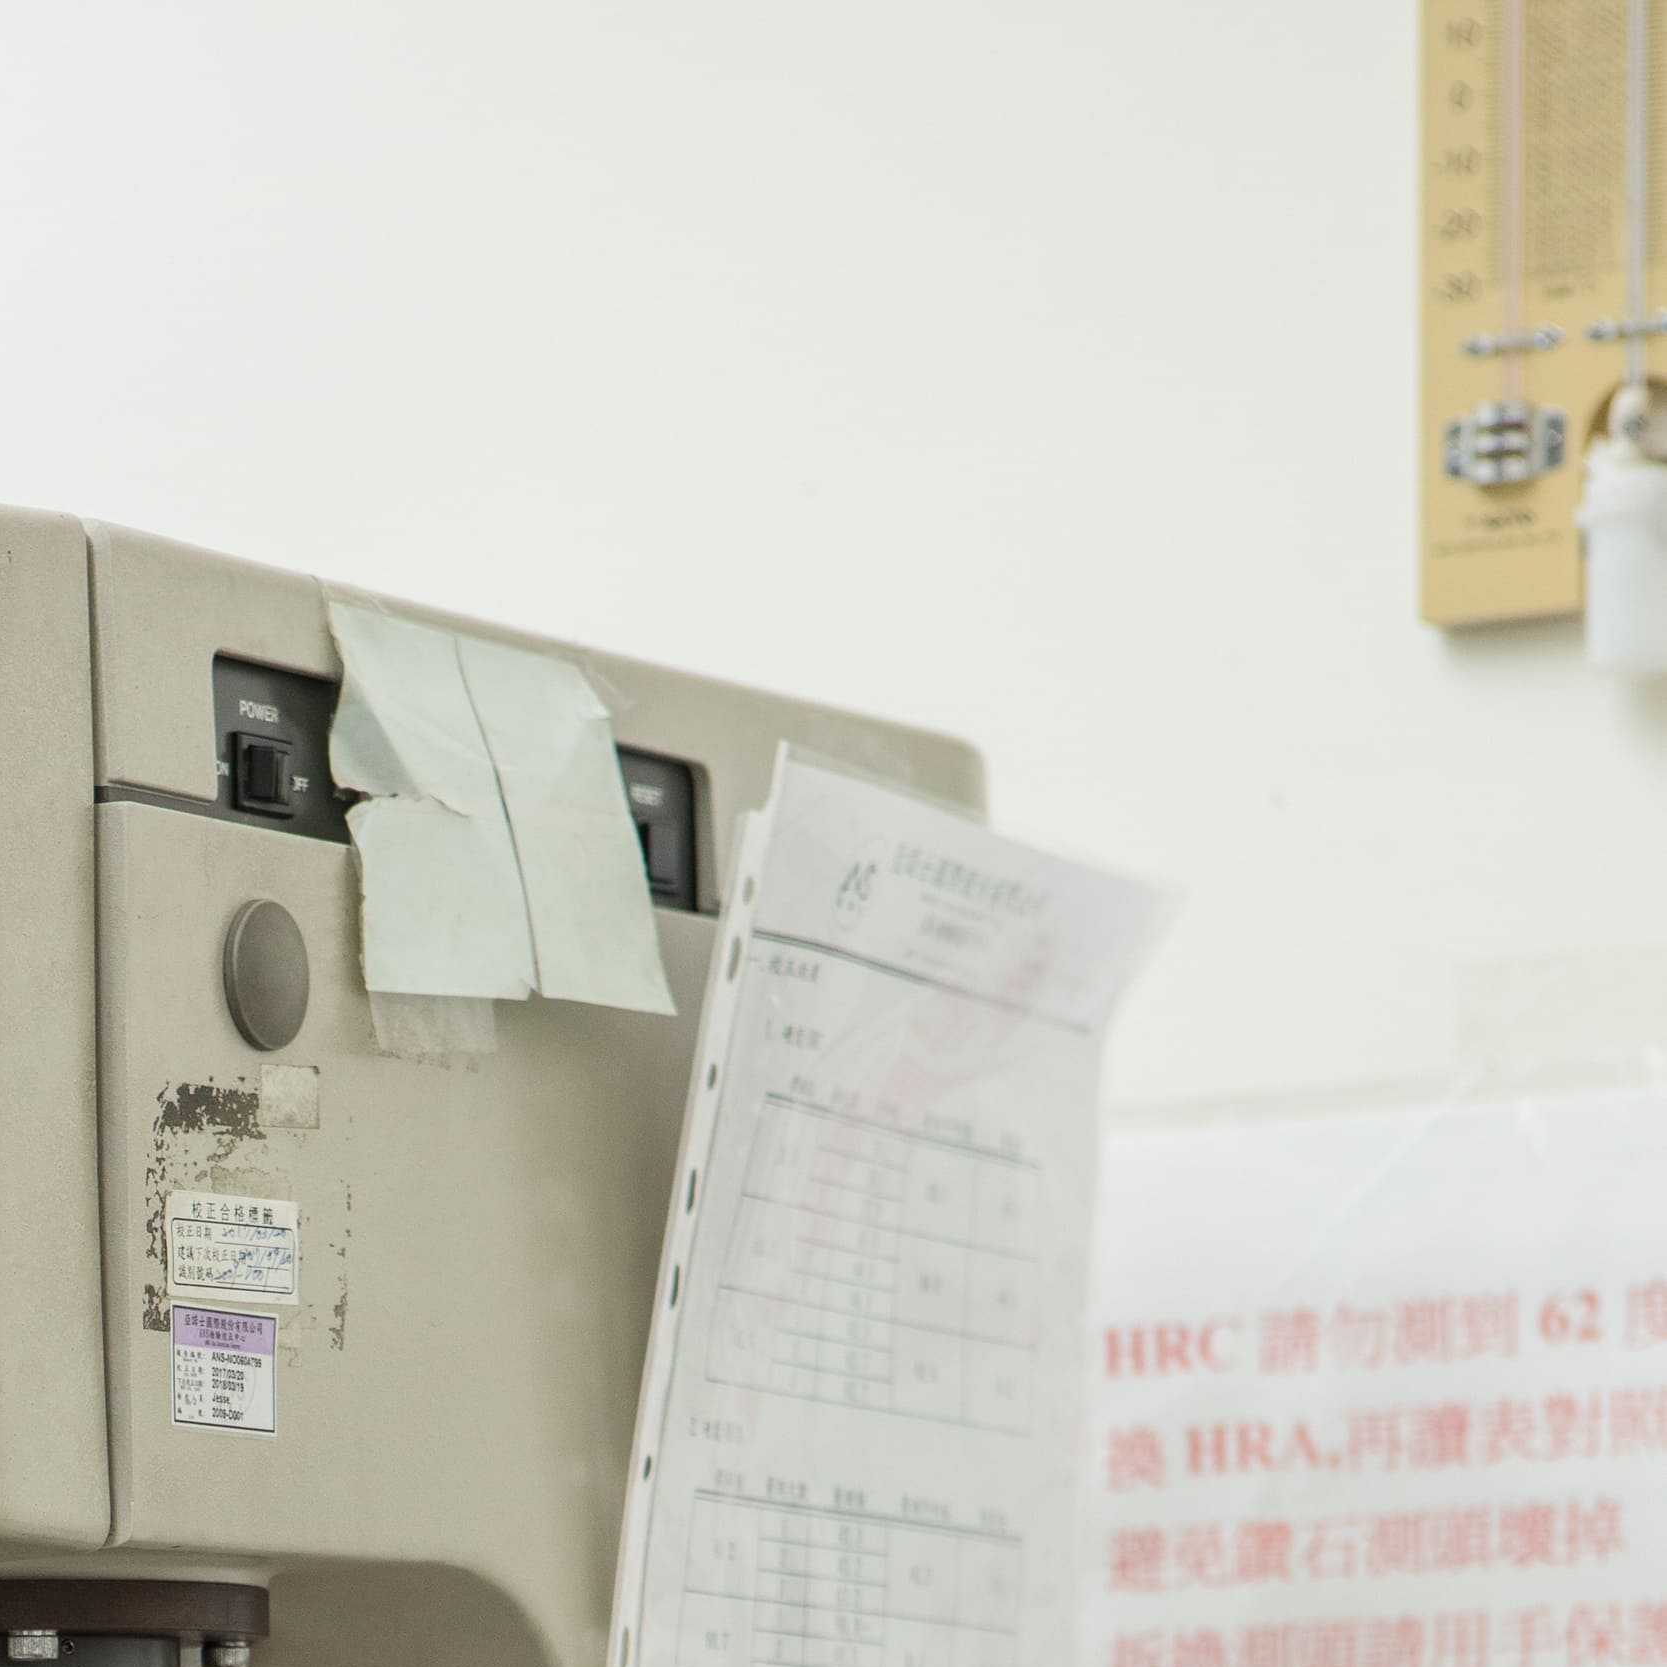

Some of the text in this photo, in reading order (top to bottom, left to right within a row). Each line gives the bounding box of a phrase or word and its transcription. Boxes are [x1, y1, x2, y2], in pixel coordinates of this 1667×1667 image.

[239, 700, 279, 723] POWER
[1103, 1319, 1242, 1379] HRC
[1537, 1288, 1603, 1344] 62
